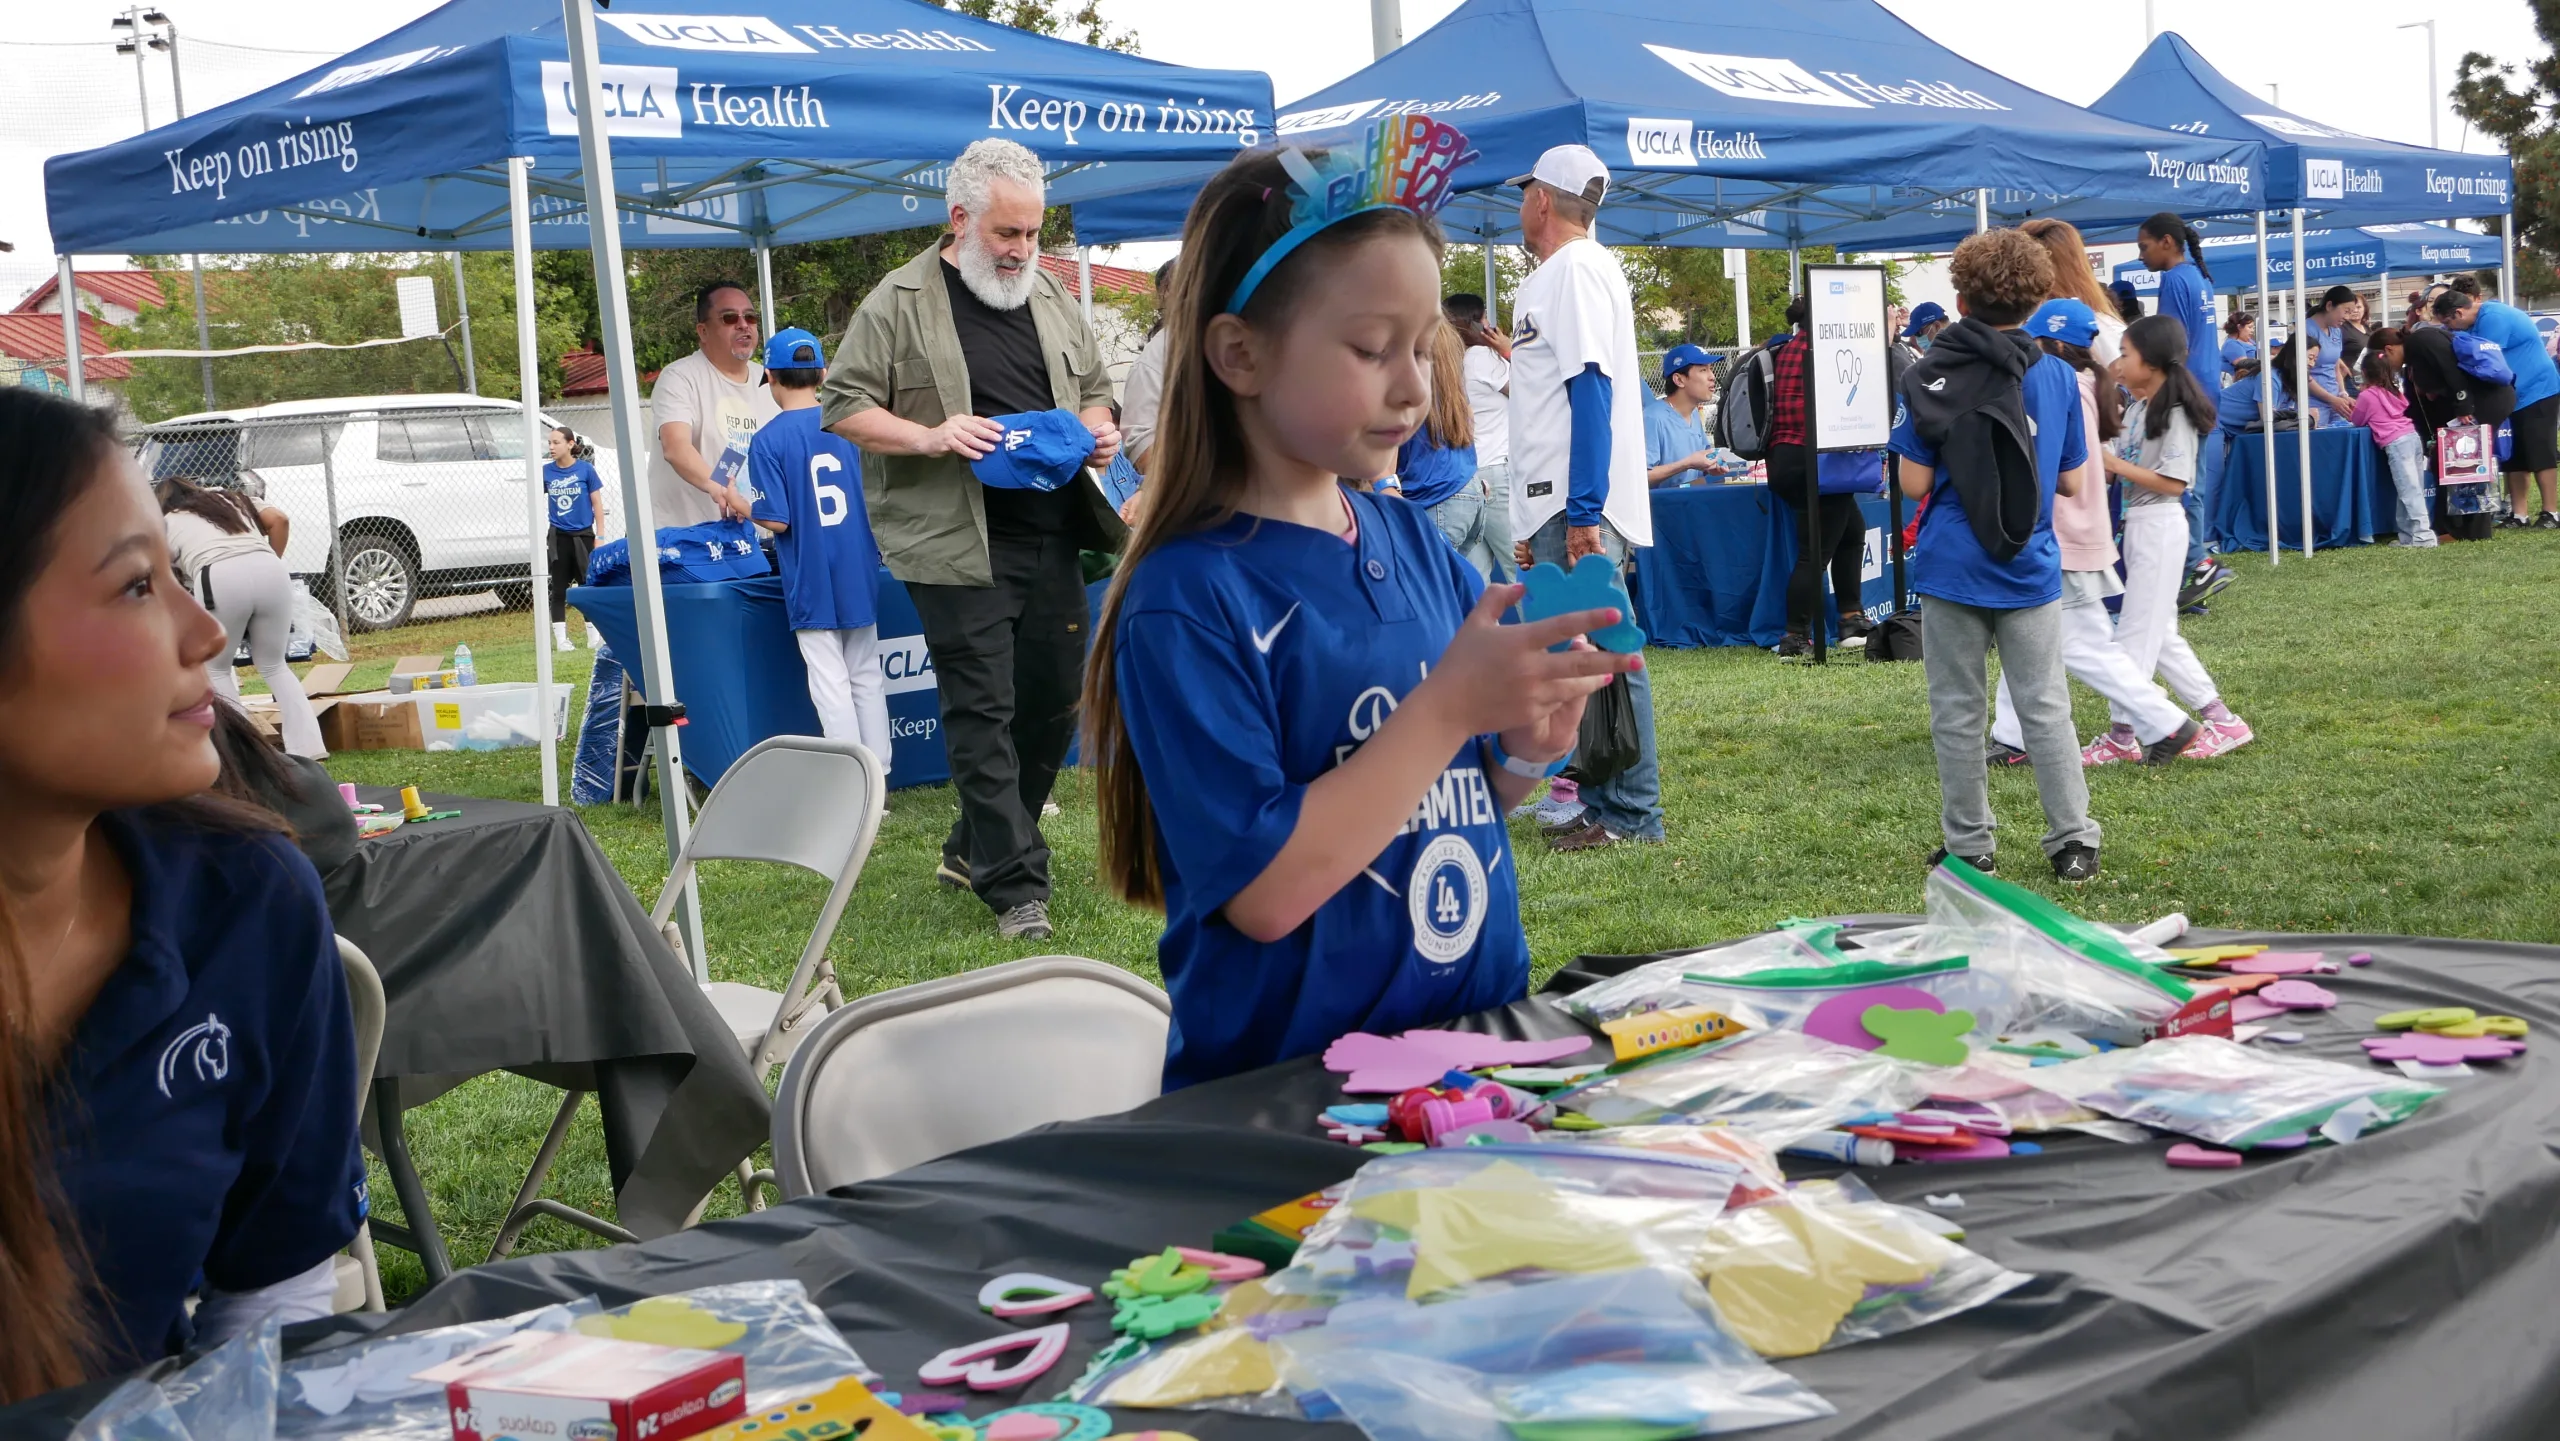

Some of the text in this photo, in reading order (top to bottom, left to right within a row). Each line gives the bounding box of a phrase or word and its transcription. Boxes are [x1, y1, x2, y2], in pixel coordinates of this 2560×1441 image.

[637, 23, 996, 52] UCLA Health
[1688, 62, 2012, 110] UCLA Health
[690, 83, 829, 128] Health
[988, 84, 1260, 147] Keep on rising
[1277, 91, 1501, 130] UCLA Health
[165, 115, 358, 201] Keep on rising
[1364, 113, 1481, 180] HAPPY
[1637, 130, 1766, 160] UCLA Health
[2145, 151, 2250, 194] Keep on rising
[2312, 167, 2383, 193] UCLA Health
[2425, 168, 2507, 204] Keep on rising
[2266, 249, 2376, 276] Kee on rising
[2421, 244, 2470, 264] Keep on rising
[2127, 273, 2156, 286] UCLA
[1819, 322, 1875, 340] DENTAL EXAMS
[743, 418, 757, 430] ON
[1005, 429, 1032, 452] LA
[810, 452, 848, 528] 6
[734, 539, 752, 556] LA
[1879, 600, 1893, 617] on
[879, 650, 936, 682] CLA
[889, 716, 937, 740] Keep
[1436, 876, 1460, 923] LA
[455, 1406, 482, 1432] 24
[498, 1414, 557, 1435] crayons
[637, 1412, 659, 1439] 24
[660, 1397, 705, 1426] crayons
